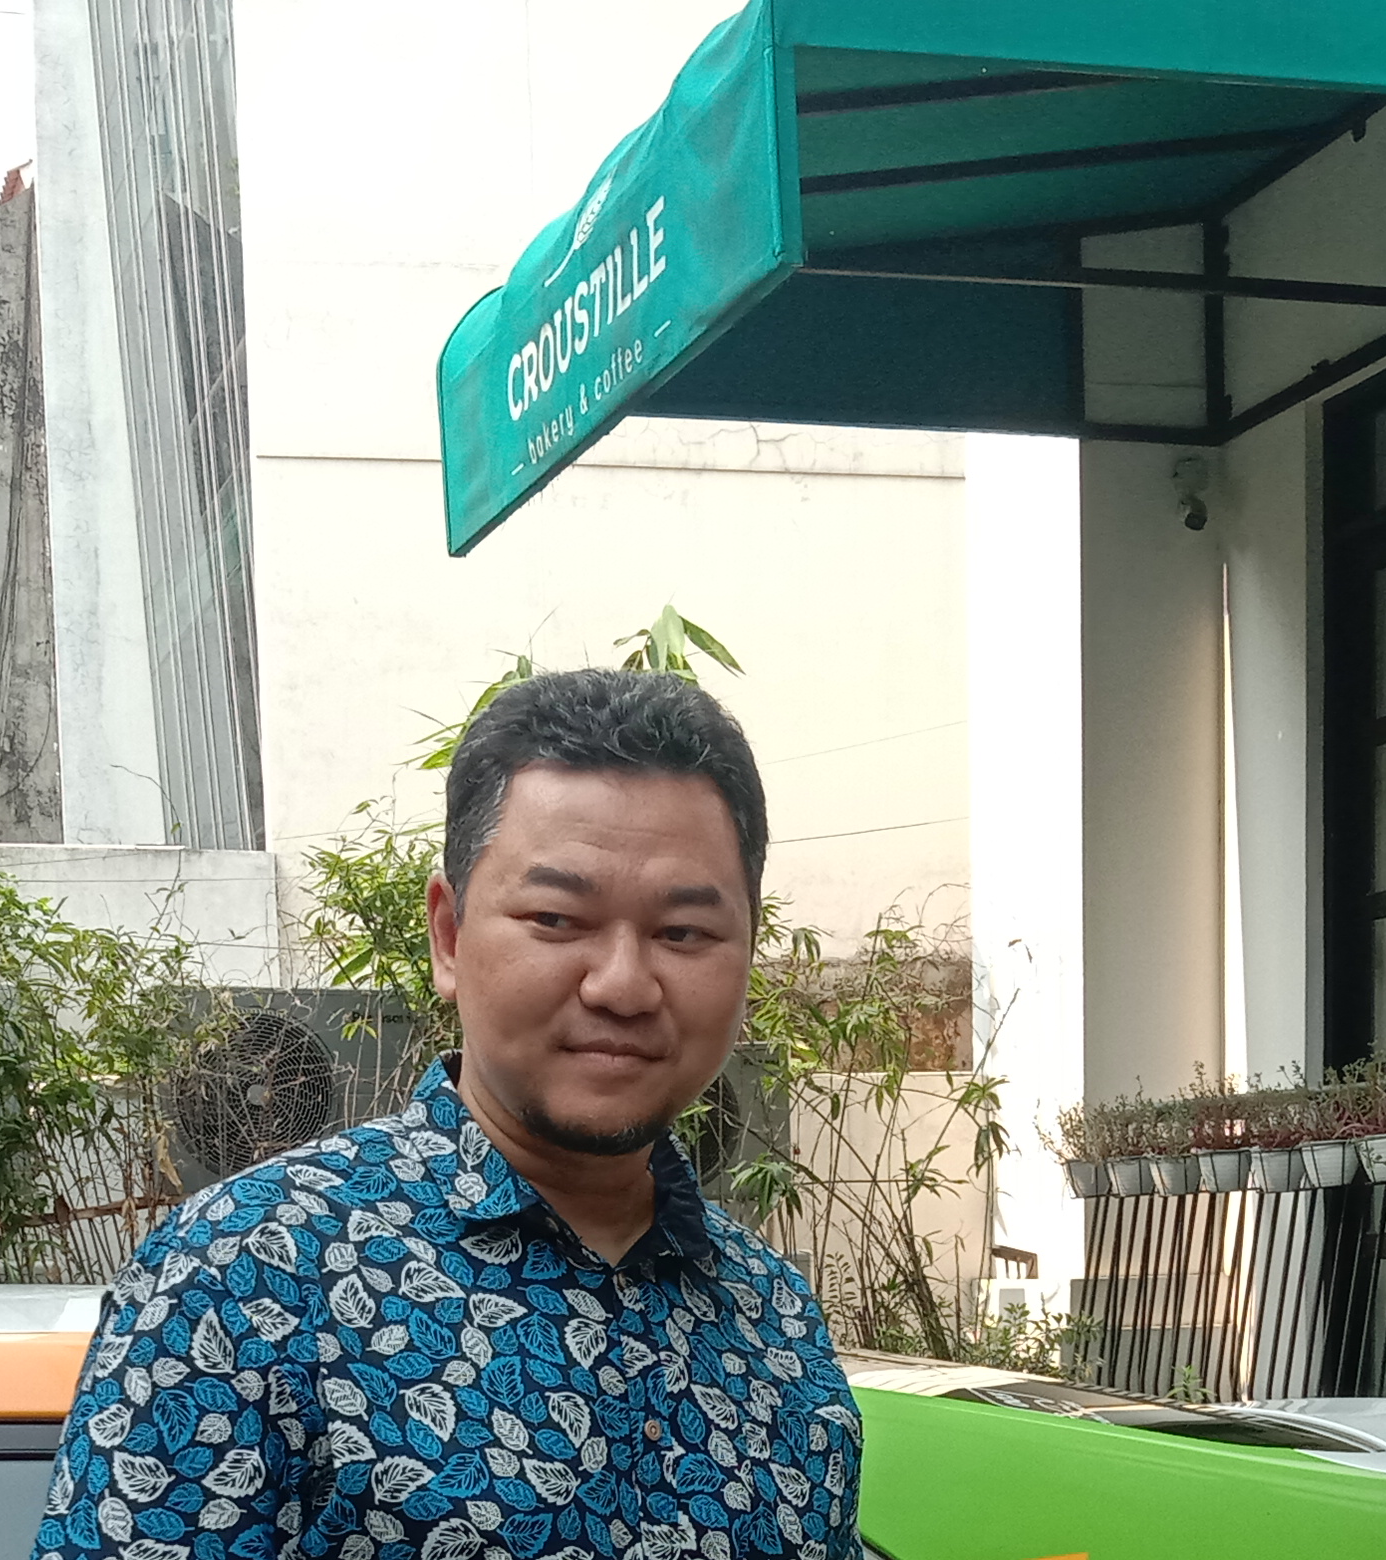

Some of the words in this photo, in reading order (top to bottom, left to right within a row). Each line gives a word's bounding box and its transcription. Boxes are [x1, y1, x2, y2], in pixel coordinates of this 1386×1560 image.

[507, 195, 666, 421] CROUSTILLE
[527, 405, 574, 464] bakery
[579, 383, 589, 415] &
[594, 339, 643, 400] coffee
